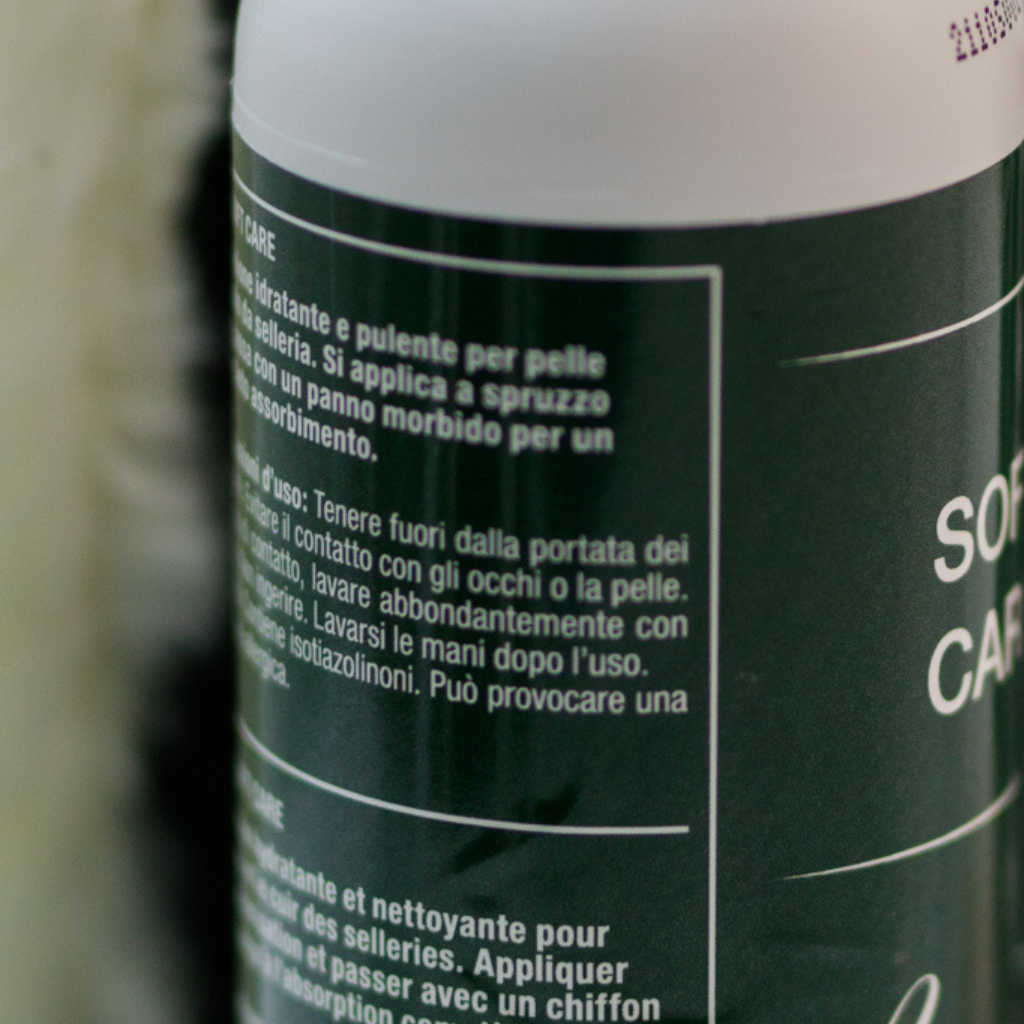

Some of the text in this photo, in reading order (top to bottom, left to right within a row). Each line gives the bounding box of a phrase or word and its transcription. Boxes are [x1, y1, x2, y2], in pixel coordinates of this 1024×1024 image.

[245, 215, 276, 262] CARE
[254, 315, 317, 368] selleria.
[322, 344, 344, 378] Si
[350, 357, 447, 402] applica
[454, 378, 475, 406] a
[481, 381, 611, 417] spruzzo
[255, 272, 331, 335] idratante
[335, 317, 350, 341] e
[356, 322, 458, 367] pulente
[465, 342, 518, 376] per
[524, 344, 606, 380] pelle
[250, 385, 378, 463] assorbimento.
[254, 351, 278, 387] con
[281, 368, 302, 399] un
[306, 381, 376, 424] panno
[382, 400, 502, 446] morbido
[509, 423, 565, 454] per
[571, 427, 615, 454] un
[262, 463, 690, 568] d'uso: Tenere fuori dalla portata dei
[282, 511, 290, 542] il
[294, 525, 373, 572] contatto
[378, 552, 422, 583] con
[429, 561, 460, 594] gli
[467, 568, 541, 599] occhi
[549, 576, 569, 601] o
[576, 573, 604, 602] la
[610, 573, 689, 608] pelle.
[312, 562, 371, 609] lavare
[379, 587, 623, 640] abbondantemente
[635, 613, 688, 639] con
[313, 599, 386, 650] Lavarsi
[393, 624, 414, 656] le
[421, 635, 486, 669] mani
[493, 643, 563, 679] dopo
[571, 645, 648, 677] l'uso.
[290, 626, 421, 696] isotiazolinoni.
[429, 668, 478, 704] Può
[487, 681, 626, 715] provocare
[635, 686, 688, 715] una
[927, 581, 1024, 716] CAR
[302, 902, 338, 942] des
[344, 924, 463, 974] selleries.
[473, 947, 629, 991] Appliquer
[343, 887, 366, 916] et
[372, 896, 526, 944] nettoyante
[536, 921, 610, 952] pour
[306, 944, 327, 974] et
[331, 956, 413, 999] passer
[421, 981, 488, 1014] avec
[498, 992, 537, 1018] un
[546, 991, 660, 1022] chiffon
